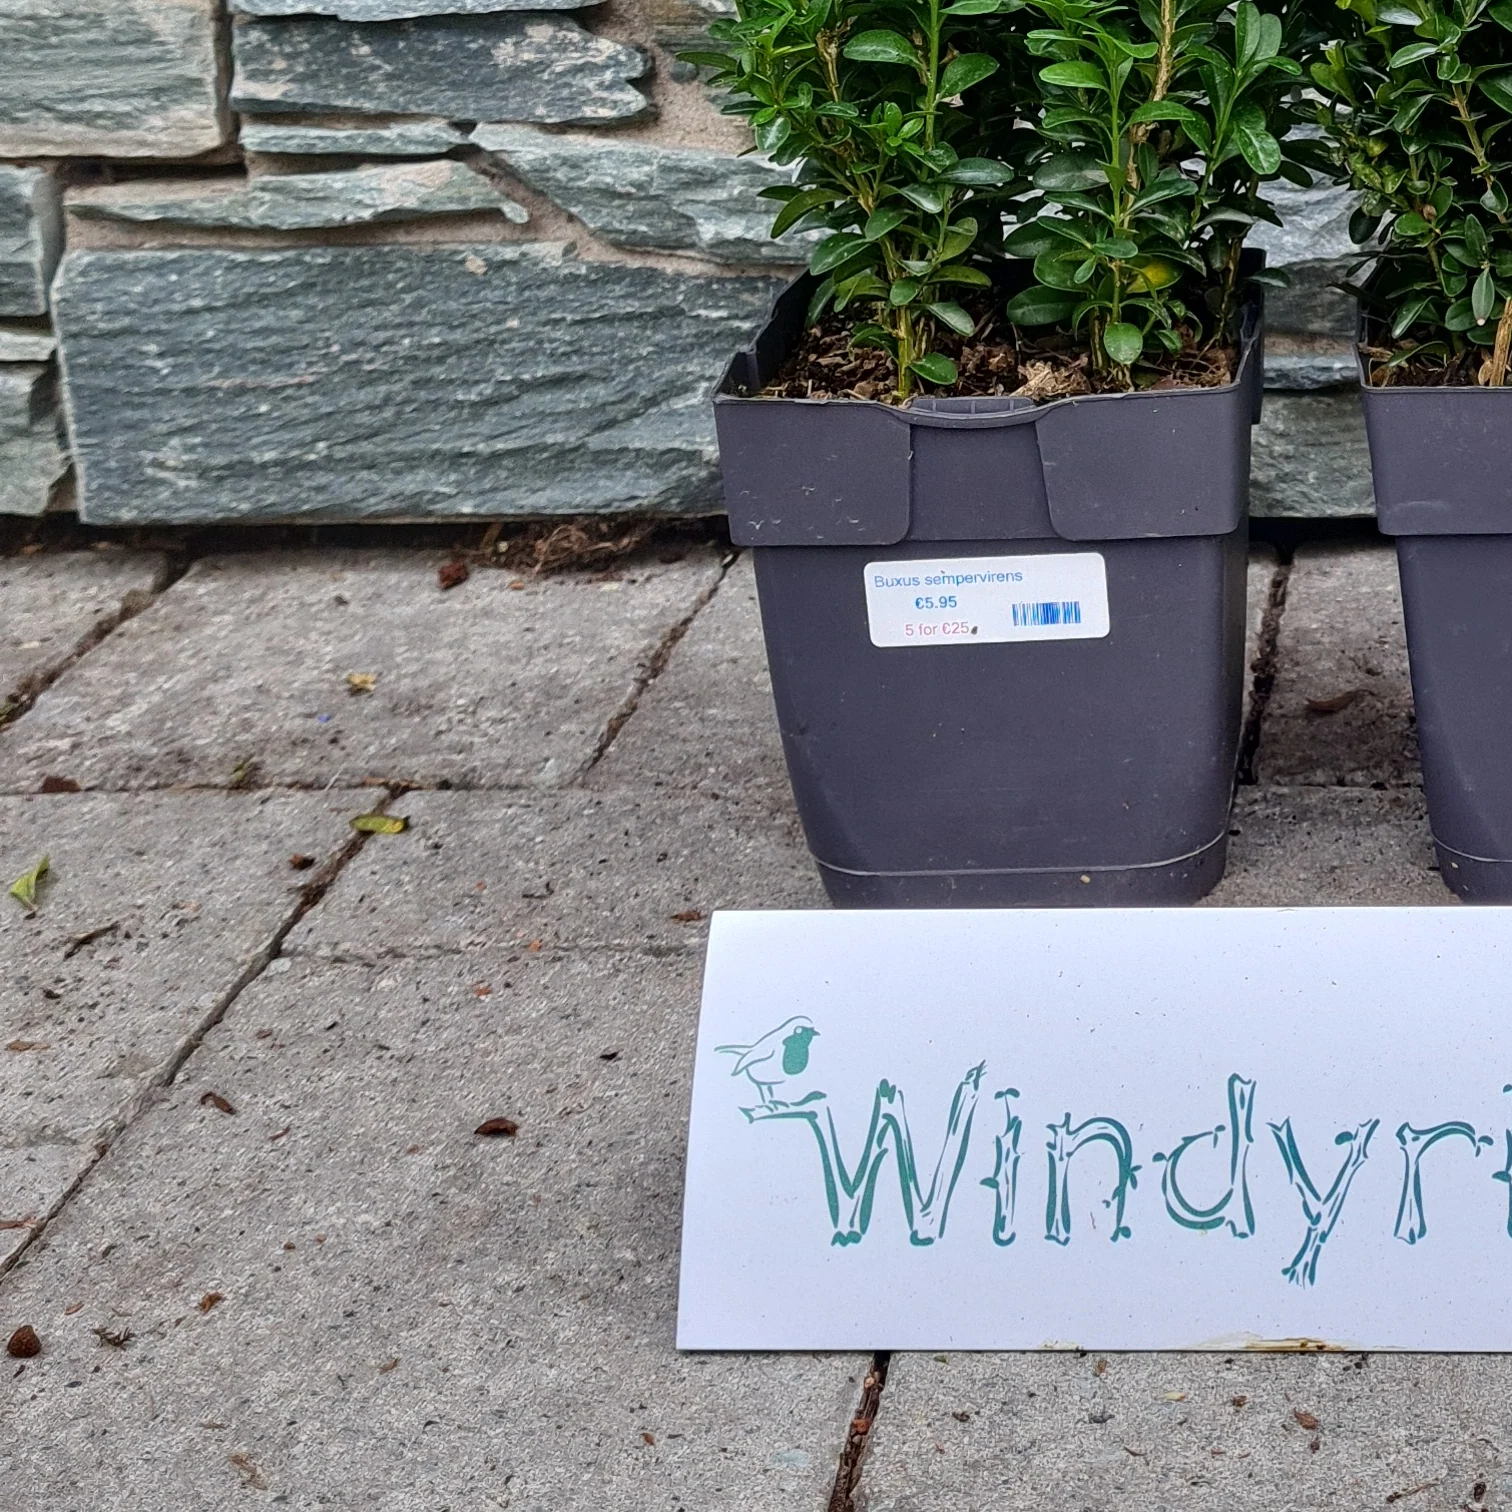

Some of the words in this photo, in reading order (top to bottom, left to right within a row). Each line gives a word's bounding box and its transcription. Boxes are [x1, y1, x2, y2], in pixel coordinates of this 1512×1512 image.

[874, 574, 921, 588] Buxus
[924, 570, 1023, 587] sempervirens
[915, 595, 957, 610] €5.95
[905, 624, 914, 636] 5
[919, 623, 937, 636] for
[942, 621, 970, 635] €25
